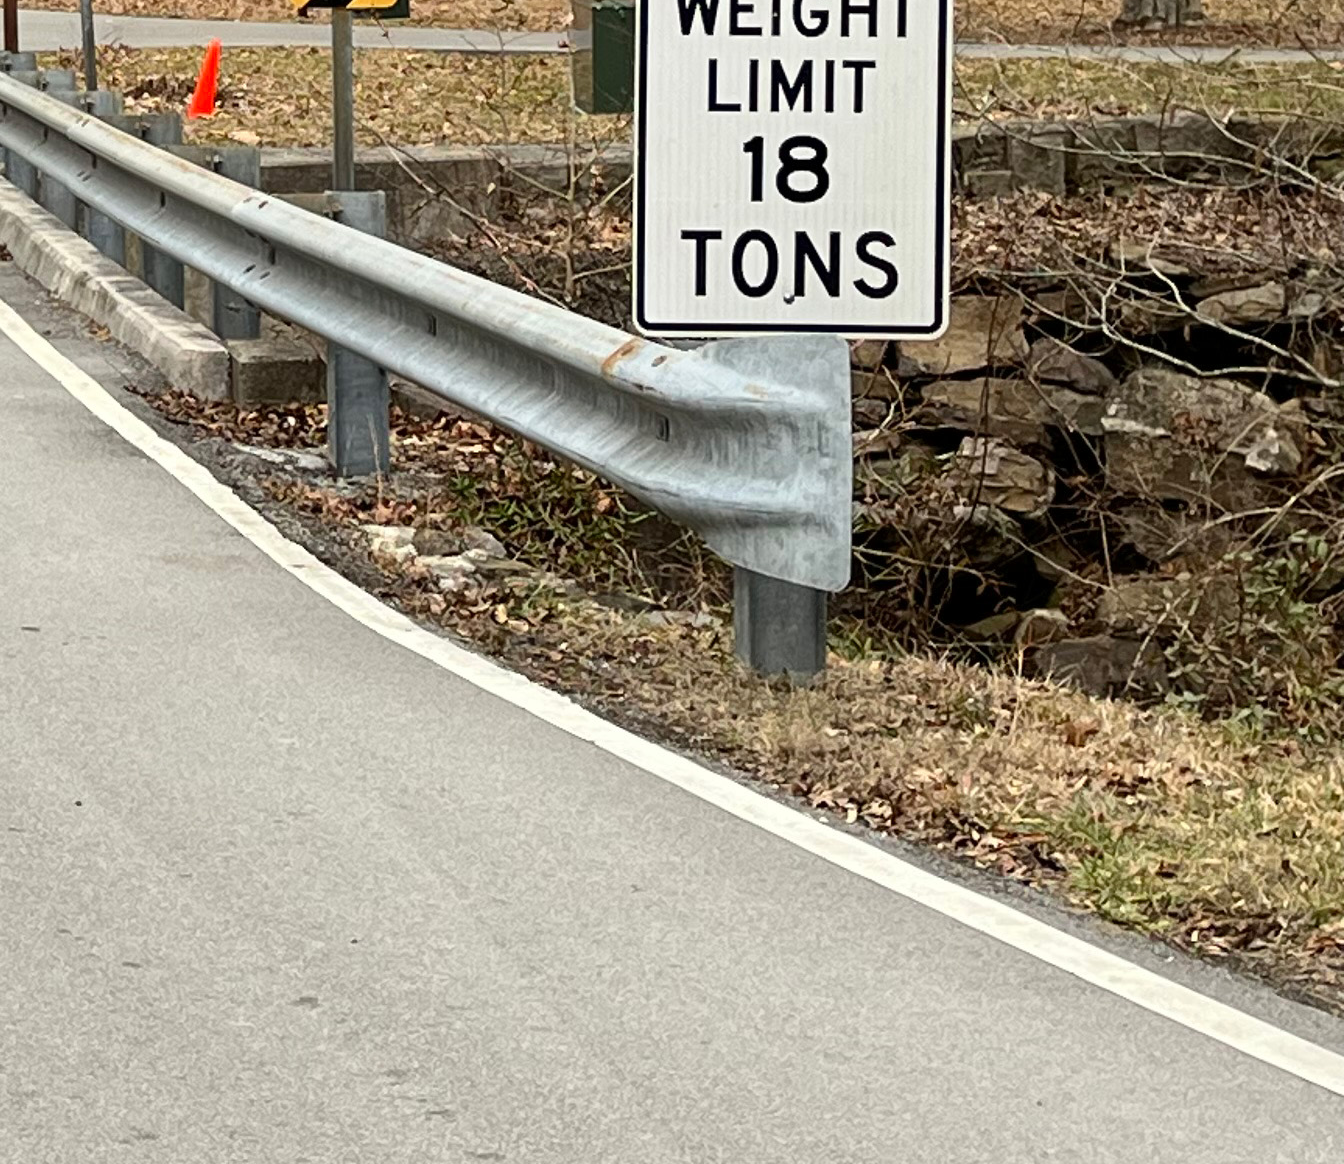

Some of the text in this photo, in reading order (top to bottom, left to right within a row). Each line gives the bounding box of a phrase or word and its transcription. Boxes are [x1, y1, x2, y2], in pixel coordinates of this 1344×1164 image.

[708, 58, 877, 114] LIMIT
[743, 135, 830, 204] 18
[680, 229, 899, 299] TONS
